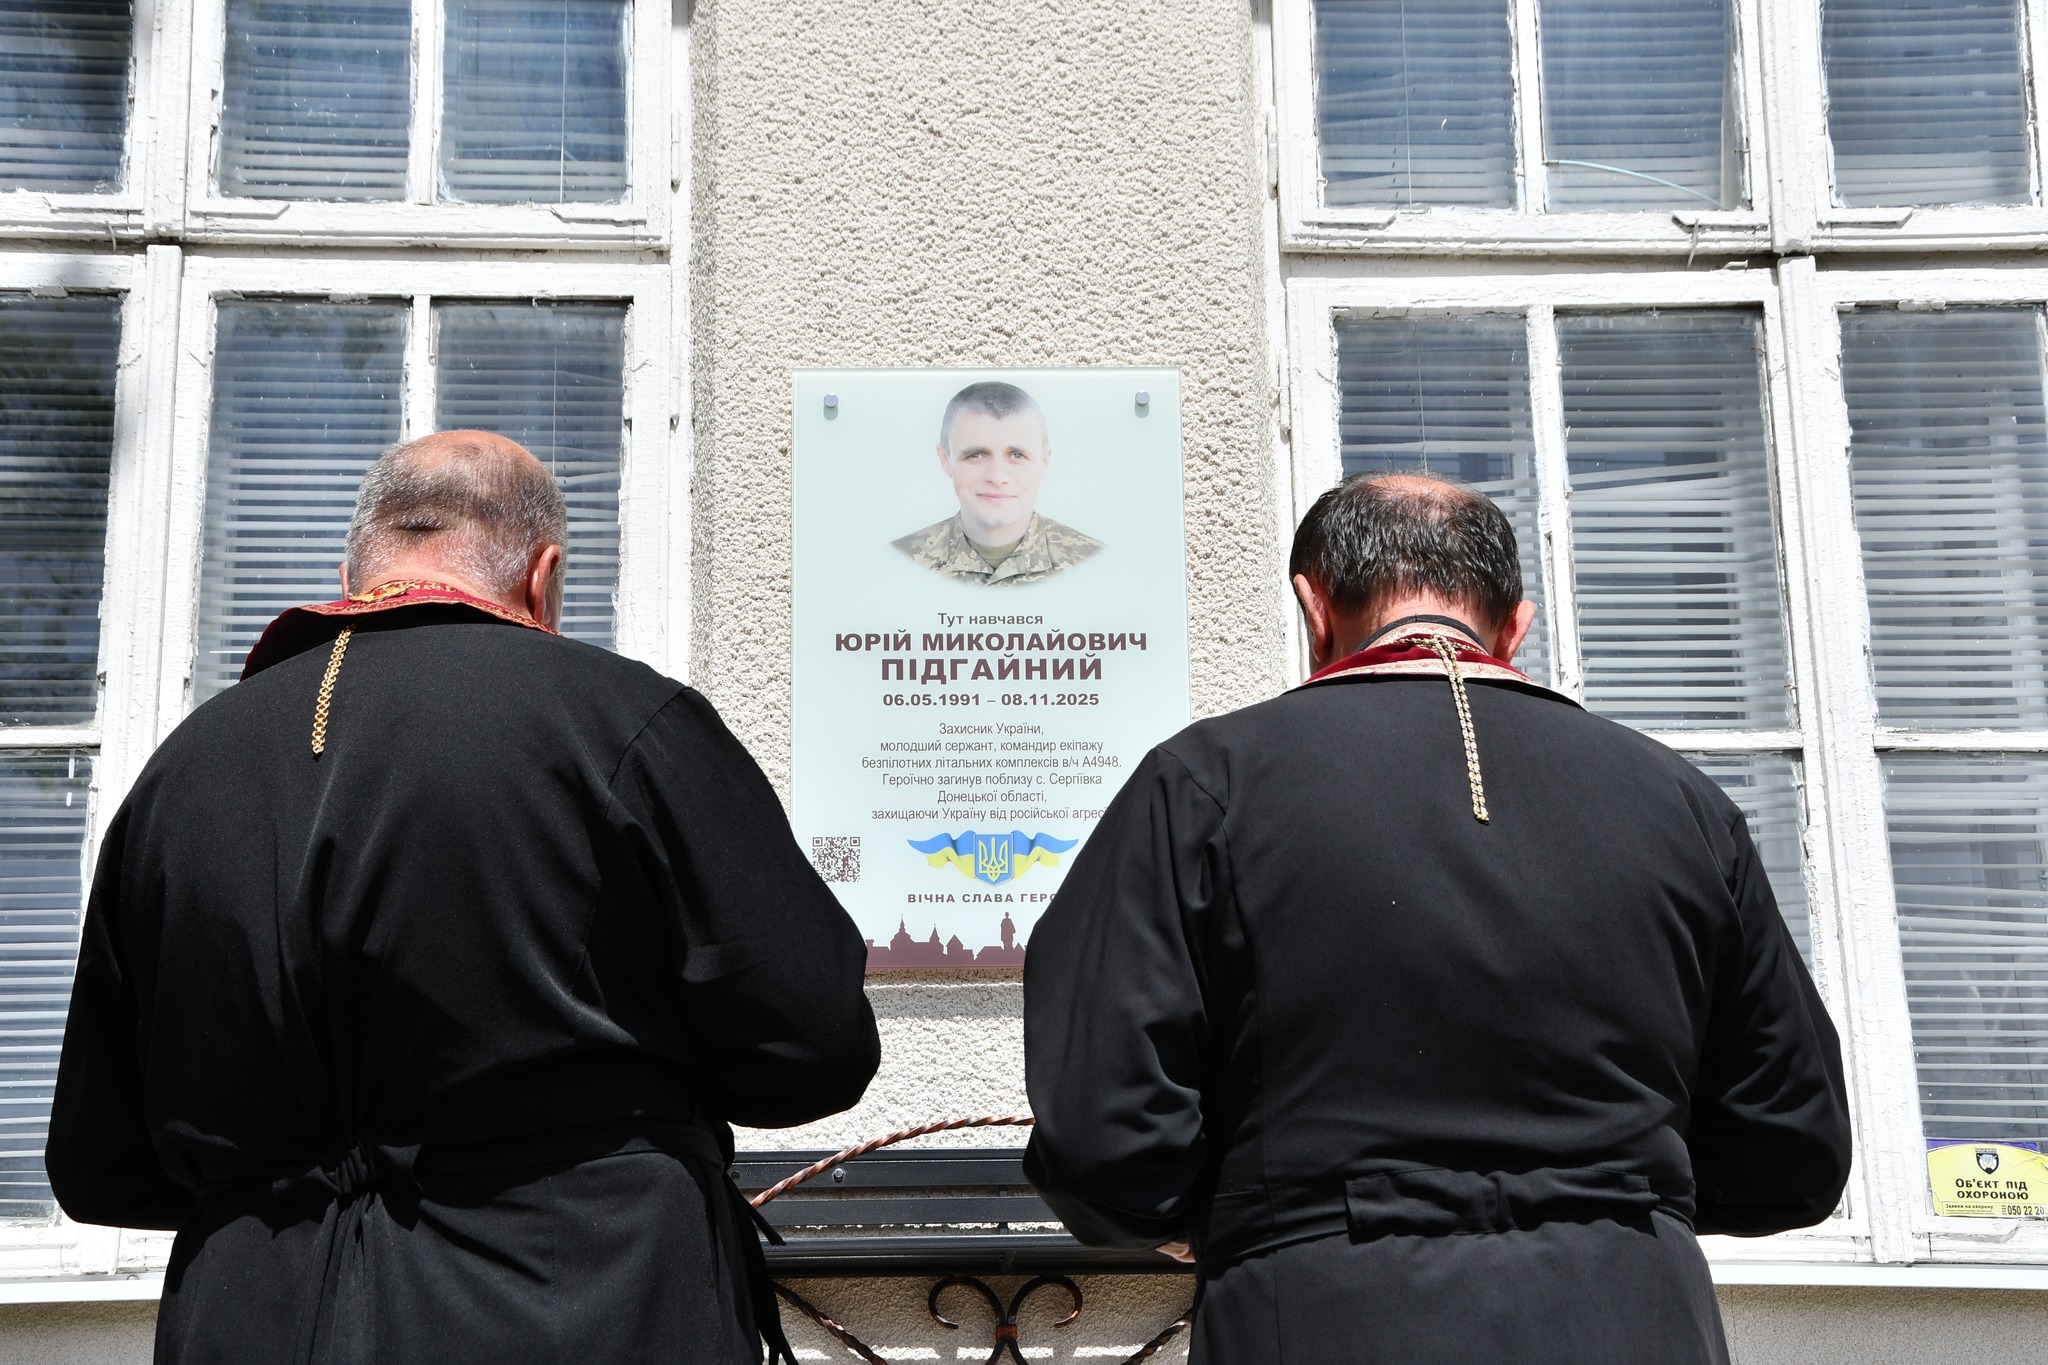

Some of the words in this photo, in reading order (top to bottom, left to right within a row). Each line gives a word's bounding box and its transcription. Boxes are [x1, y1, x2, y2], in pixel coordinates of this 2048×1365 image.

[937, 612, 965, 627] Тут
[968, 615, 1044, 625] навчався
[835, 629, 912, 652] ЮРІЙ
[922, 629, 1147, 652] МИКОЛАЙОВИЧ
[881, 653, 1103, 685] ПІДГАЙНИЙ
[882, 693, 980, 706] 06.05.1991
[1000, 693, 1100, 706] 08.11.2025
[939, 722, 994, 735] Захисник
[996, 721, 1044, 737] України,
[880, 738, 942, 753] молодший
[944, 741, 998, 755] сержант,
[1000, 741, 1057, 755] командир
[1059, 738, 1104, 755] екіпажу
[861, 756, 932, 769] безпілотних
[935, 756, 993, 769] літальних
[995, 755, 1059, 768] комплексів
[1062, 756, 1079, 768] в/ч
[1082, 756, 1122, 768] А4948.
[882, 772, 935, 786] Героїчно
[937, 775, 983, 787] загинув
[985, 772, 1034, 787] поблизу
[1036, 775, 1046, 785] с.
[1049, 772, 1102, 787] Сергіївка
[937, 789, 998, 804] Донецької
[1000, 789, 1047, 804] області,
[871, 809, 939, 822] захищаючи
[941, 807, 987, 822] Україну
[989, 806, 1007, 820] від
[1010, 806, 1070, 822] російської
[1072, 806, 1107, 822] агрес
[907, 893, 956, 904] ВІЧНА
[962, 893, 1014, 903] СЛАВА
[2005, 1181, 2028, 1191] ПІД
[1956, 1190, 2029, 1200] ОХОРОНОЮ
[2007, 1205, 2022, 1216] 050
[2023, 1205, 2033, 1216] 22
